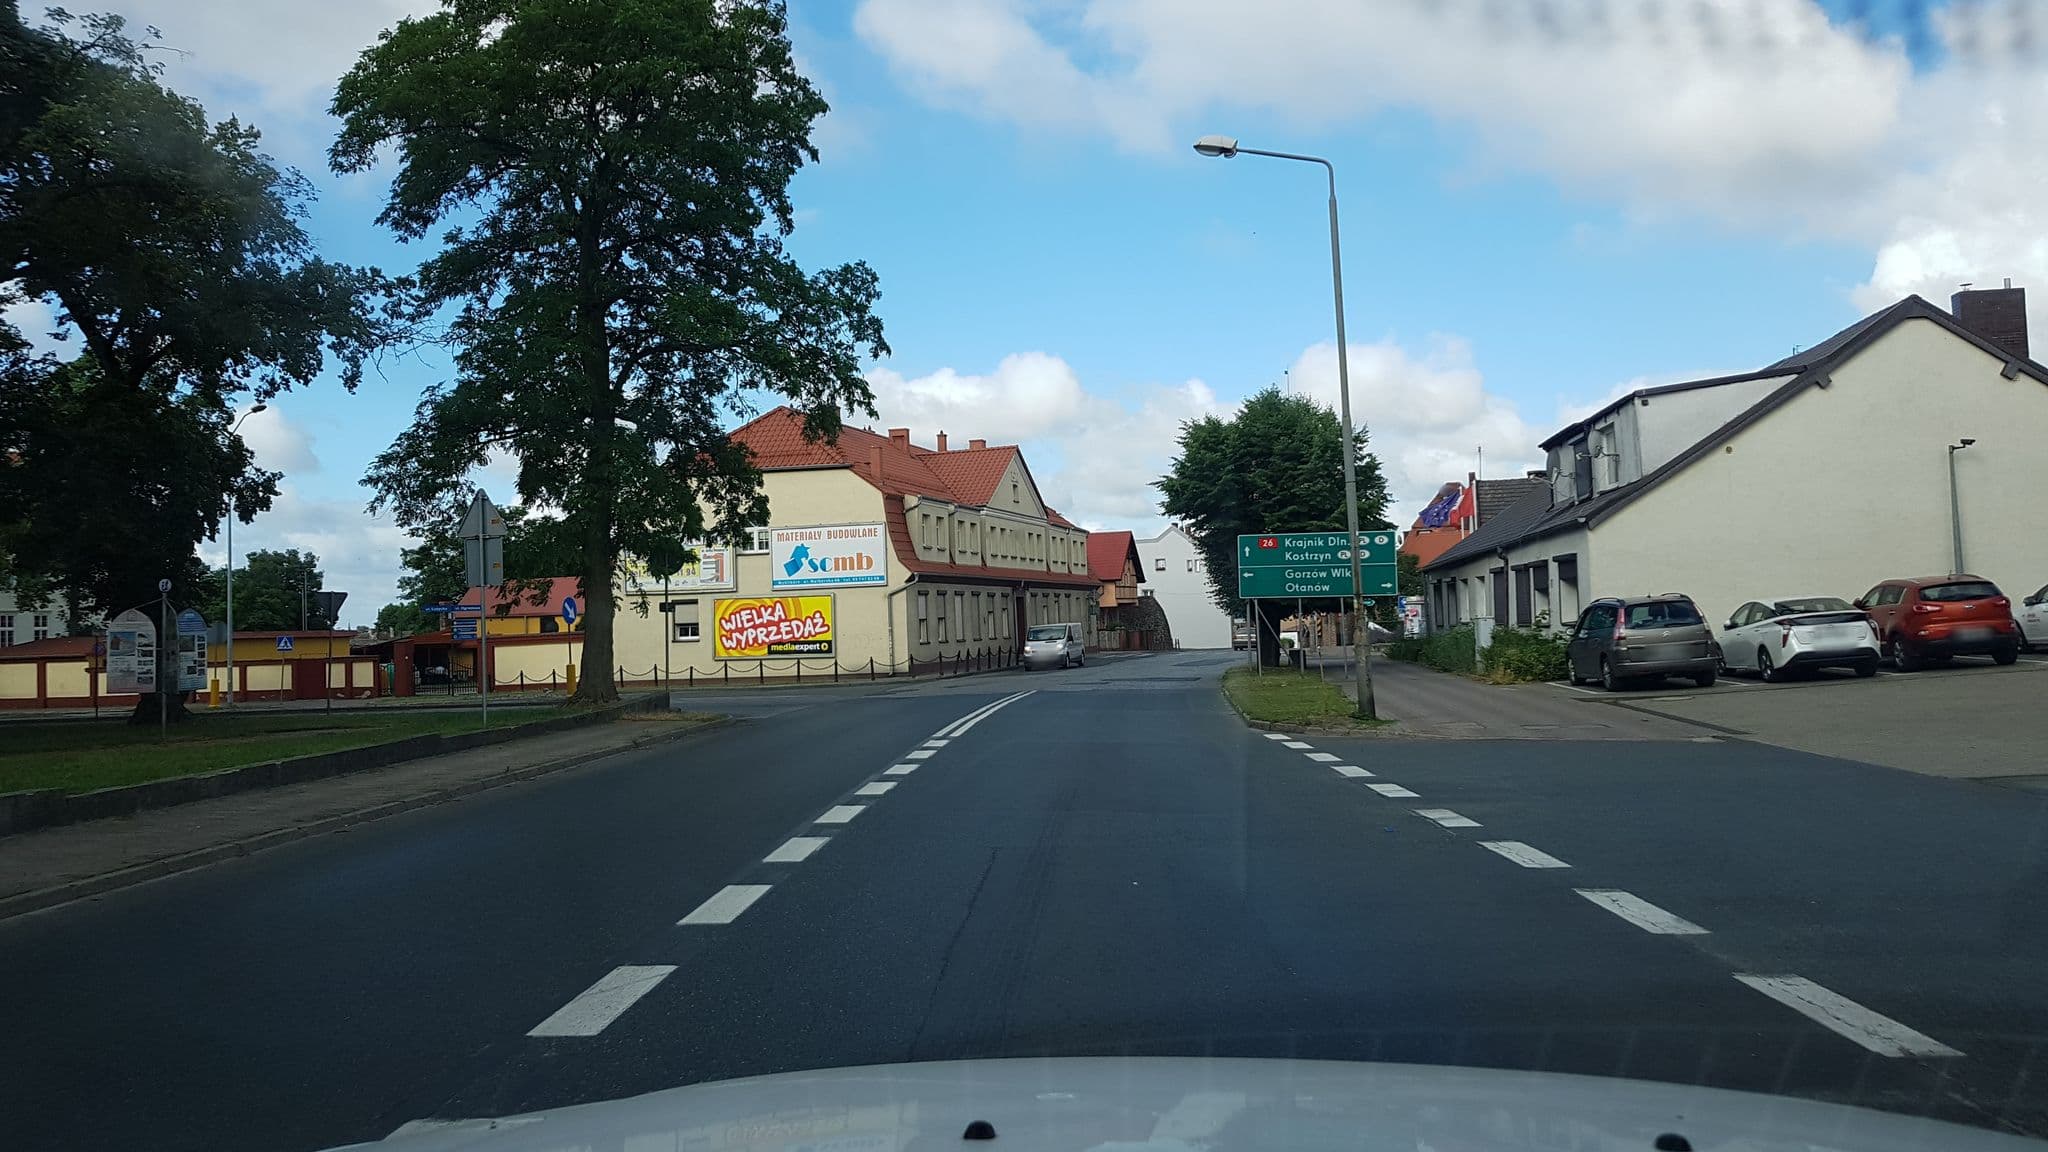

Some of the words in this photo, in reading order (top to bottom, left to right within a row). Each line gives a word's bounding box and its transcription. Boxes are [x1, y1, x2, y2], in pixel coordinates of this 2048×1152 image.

[777, 530, 822, 542] MATERIAŁY
[827, 527, 878, 540] BUDOWLANE
[1262, 539, 1274, 547] 26
[1285, 536, 1324, 549] Krajnik
[1285, 551, 1332, 563] Kostrzyn
[1285, 568, 1327, 579] Gorzów
[1285, 582, 1330, 592] Otanów
[720, 601, 785, 631] WIELKA
[721, 612, 829, 649] WYPRZEDAŻ
[771, 642, 820, 652] mediaexpert
